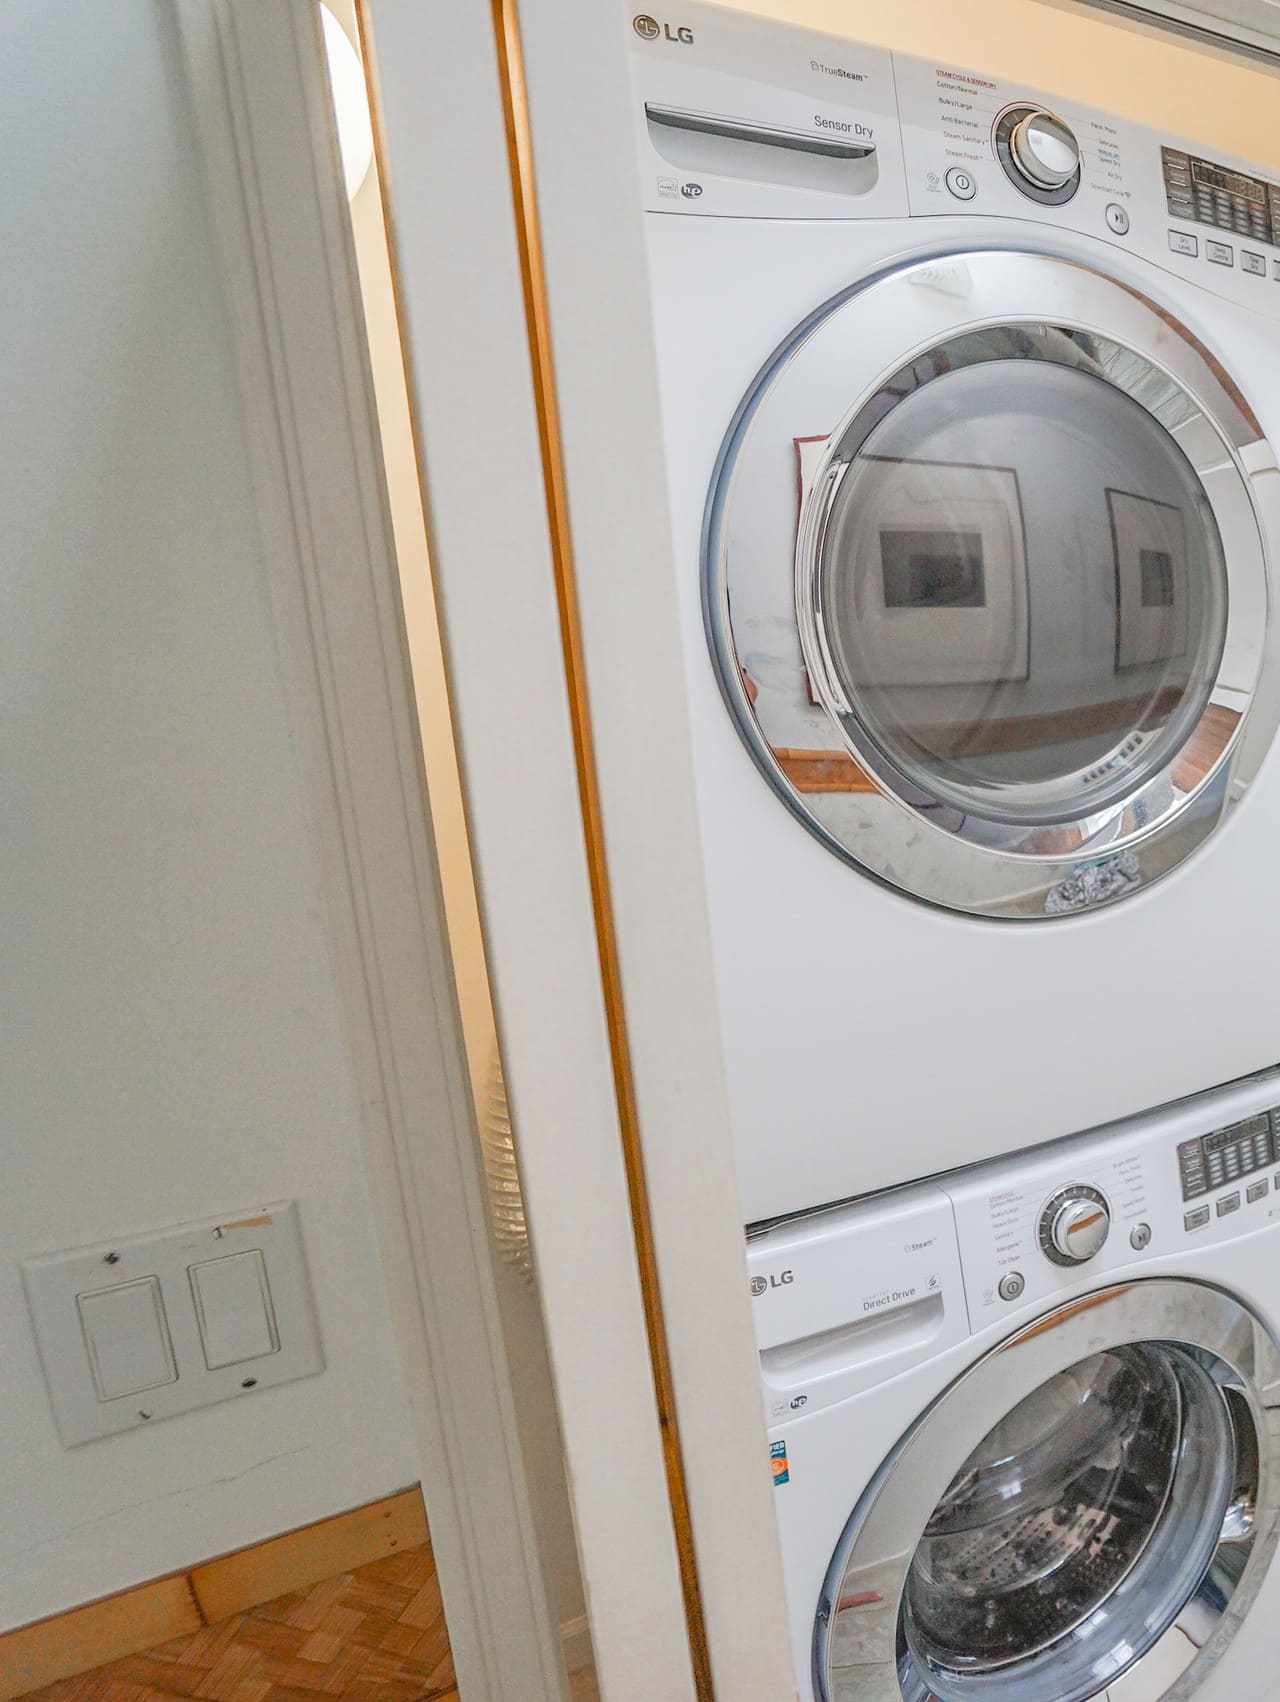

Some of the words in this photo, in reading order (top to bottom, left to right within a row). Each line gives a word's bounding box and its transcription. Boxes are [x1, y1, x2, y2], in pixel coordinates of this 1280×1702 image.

[664, 23, 694, 45] LG
[814, 115, 852, 133] Sensor
[855, 123, 874, 139] Dry
[912, 1239, 933, 1251] Steam
[770, 1270, 794, 1288] LG
[863, 1296, 891, 1311] Direct
[892, 1288, 915, 1302] Drive
